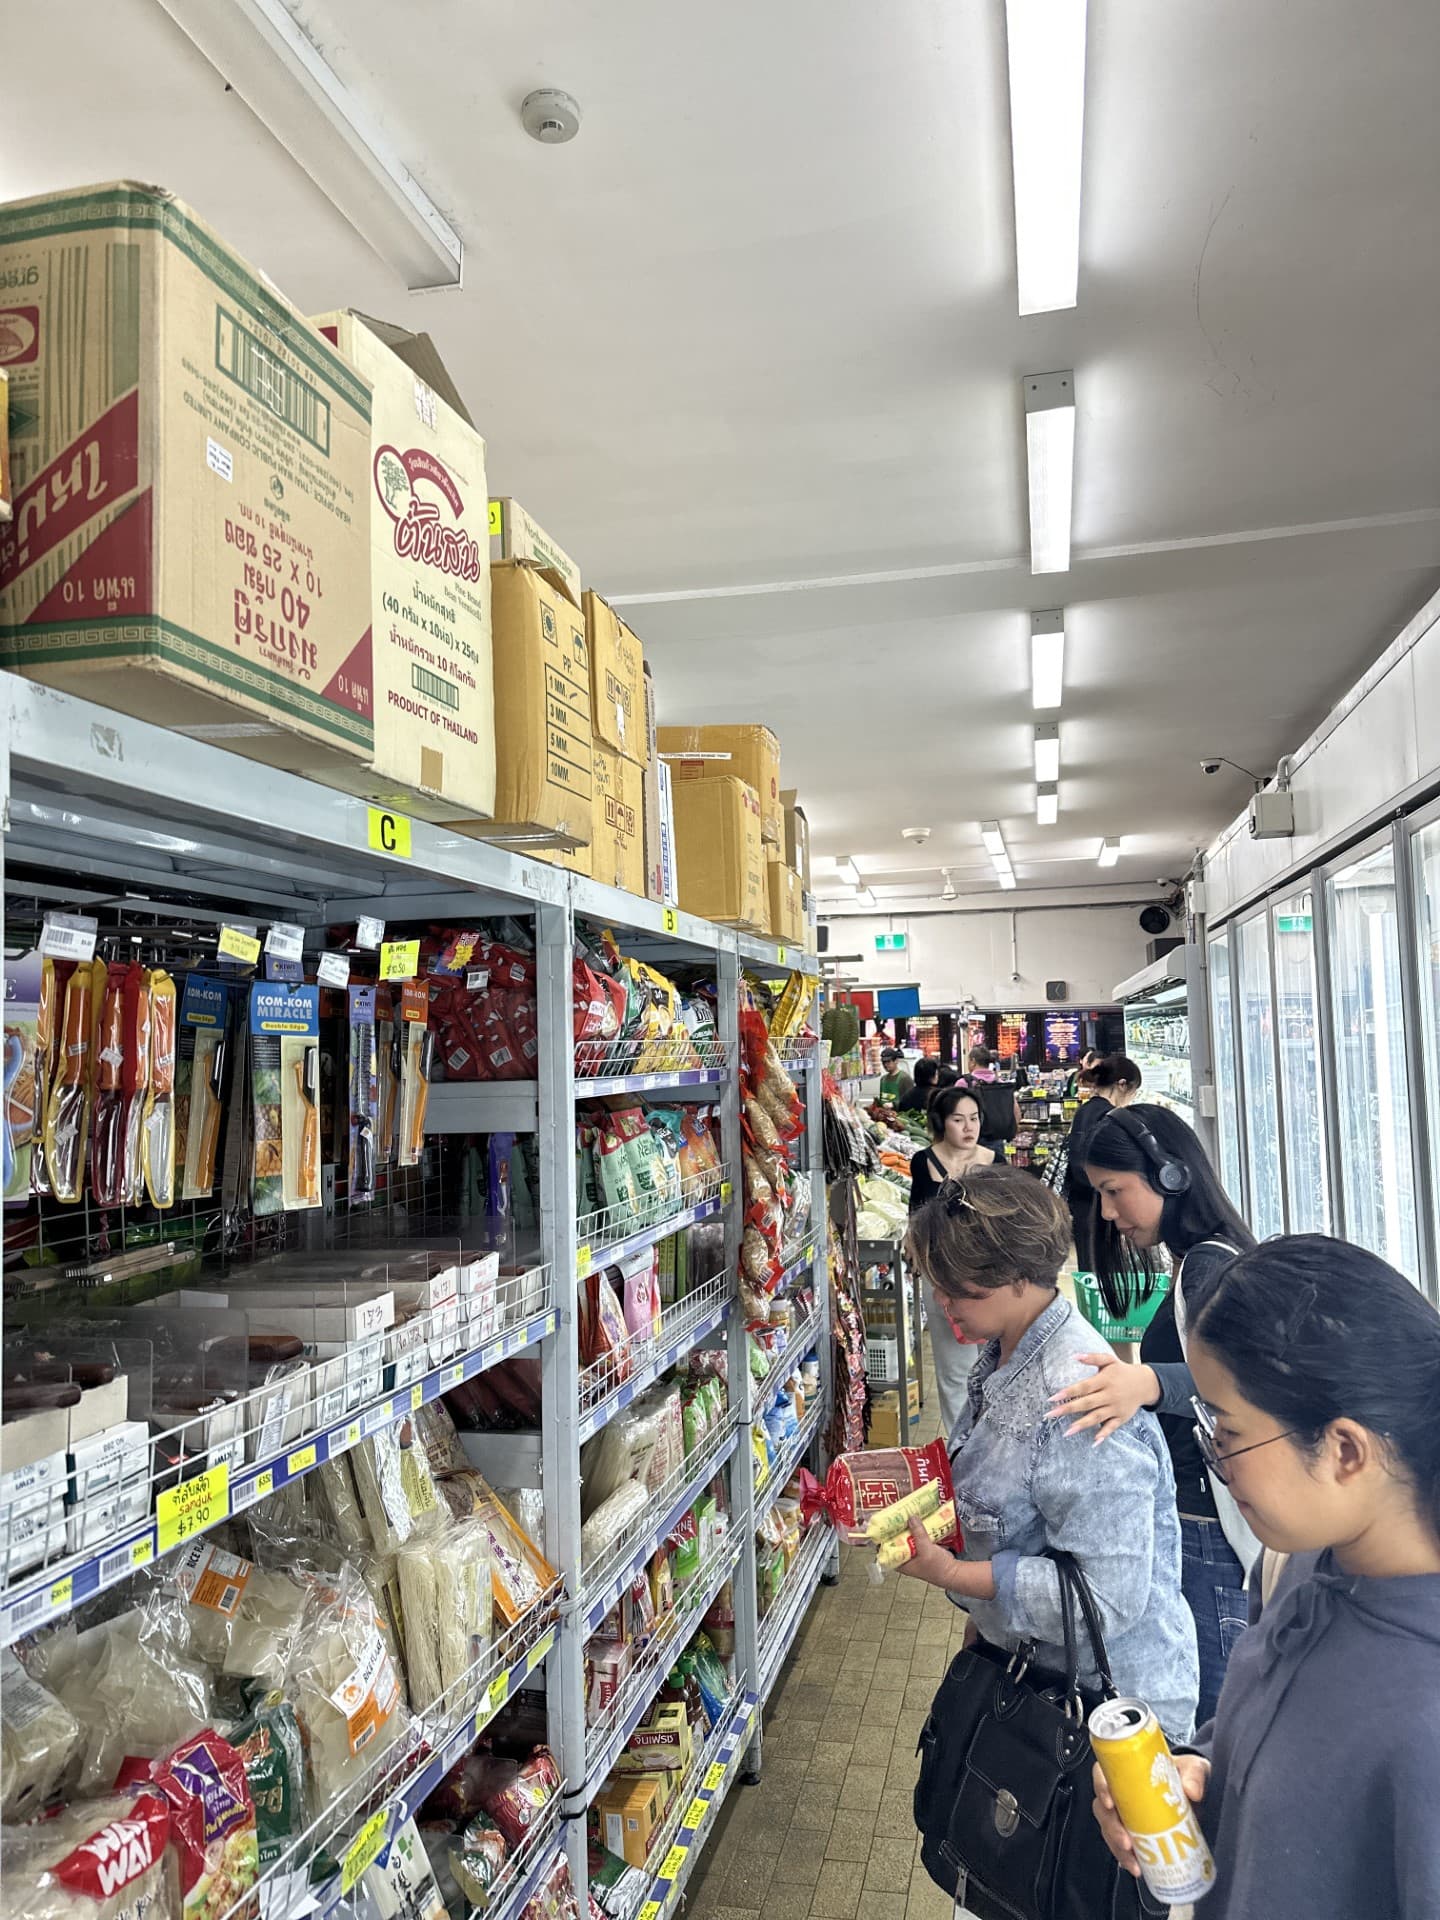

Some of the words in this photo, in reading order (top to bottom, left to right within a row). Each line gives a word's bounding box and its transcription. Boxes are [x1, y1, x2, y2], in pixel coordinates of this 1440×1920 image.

[225, 519, 258, 560] ซอง
[394, 494, 480, 583] ต้นสน
[263, 544, 282, 572] 25
[63, 580, 85, 603] 10
[94, 577, 136, 612] แพ็ค
[244, 562, 277, 605] กรัม
[306, 570, 322, 598] 10
[281, 587, 311, 630] 40
[234, 588, 318, 680] มังกรคู่
[437, 655, 449, 673] 10
[337, 674, 350, 695] 10
[388, 690, 429, 721] PRODUCT
[430, 711, 441, 726] OF
[442, 716, 479, 745] THAILAND
[550, 704, 555, 717] 3
[550, 734, 555, 747] 5
[381, 815, 396, 851] C
[666, 910, 675, 932] B
[187, 986, 222, 1001] KOM-KOM
[257, 995, 313, 1009] KOM-KOM
[257, 1006, 313, 1020] MIRACLE
[15, 1477, 35, 1491] KIWI
[177, 1507, 210, 1537] $7.90
[96, 1830, 153, 1896] WAI
